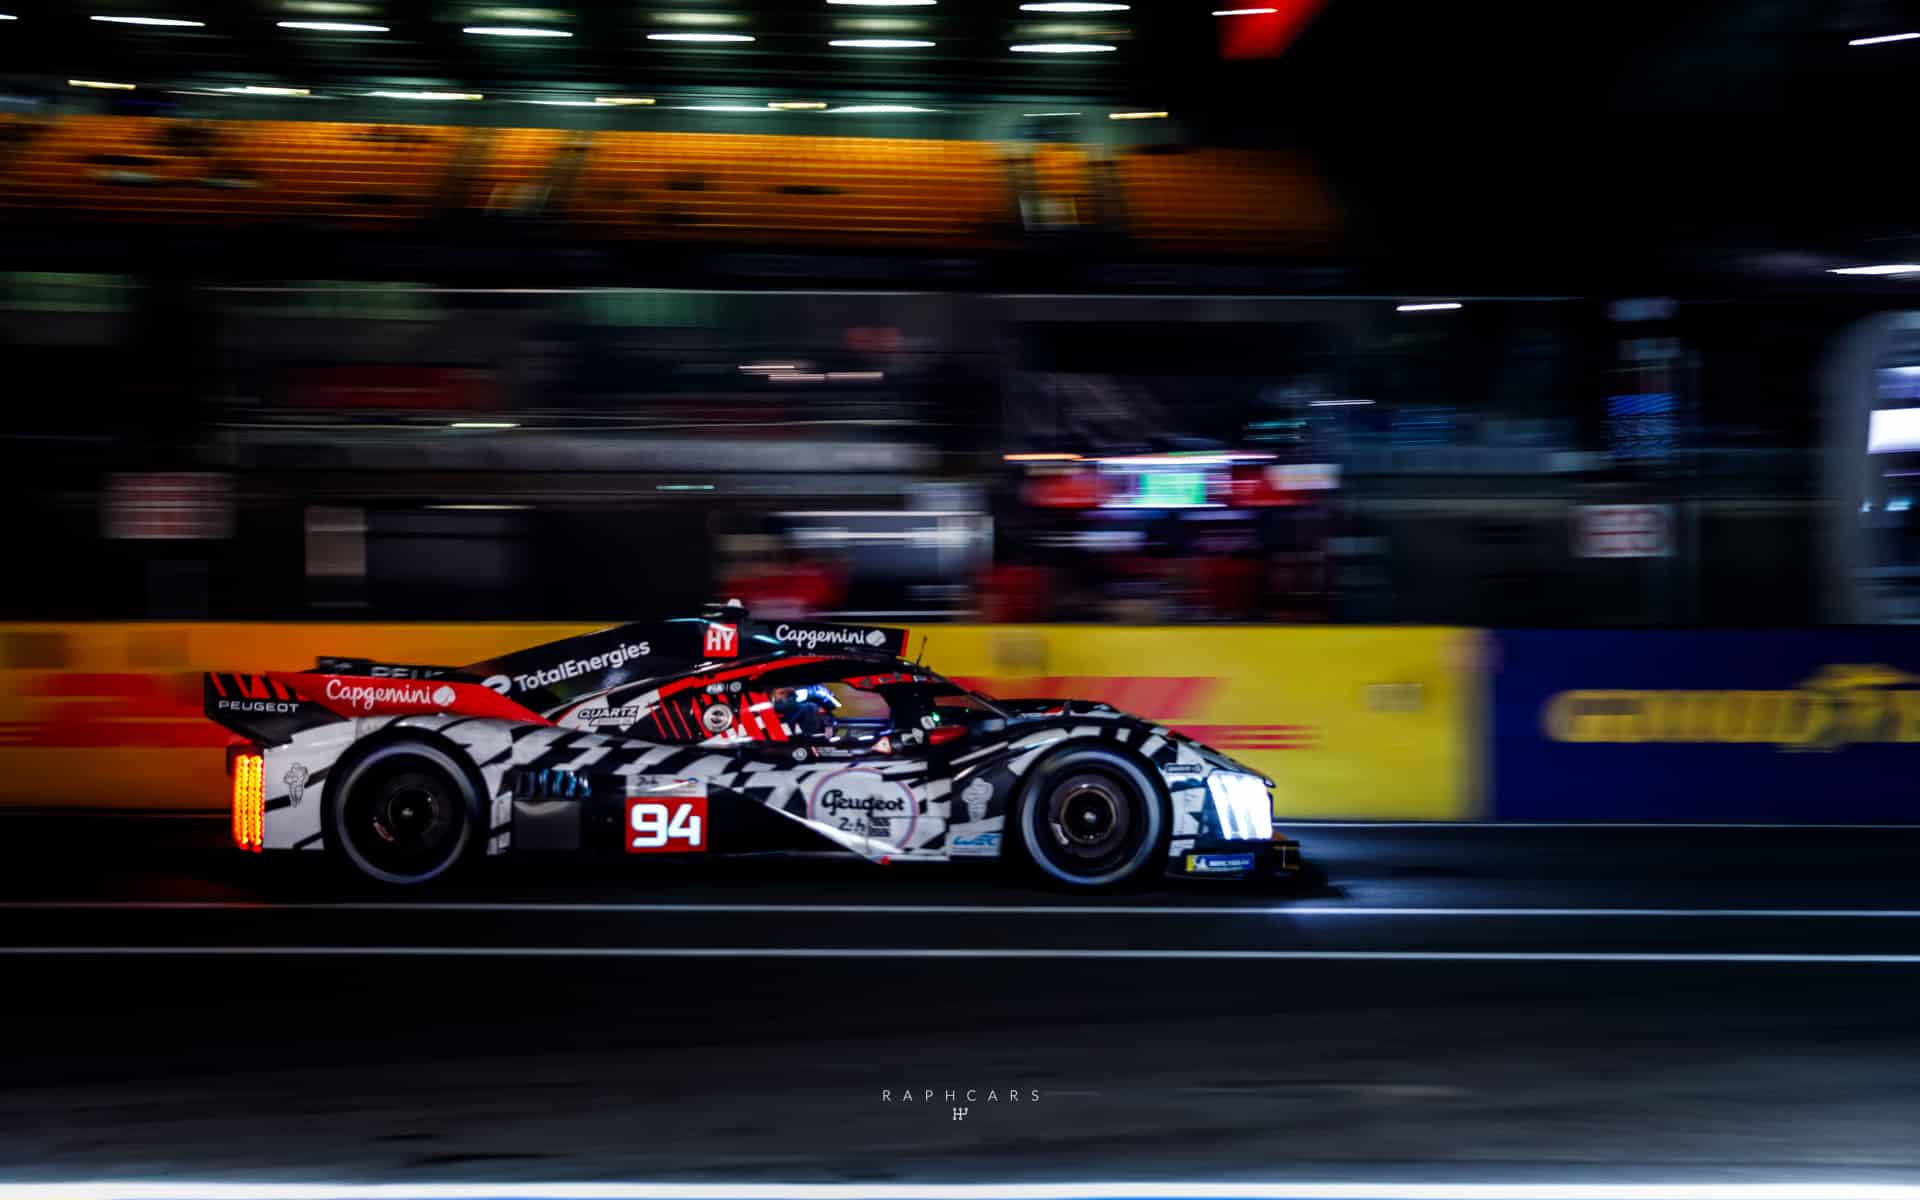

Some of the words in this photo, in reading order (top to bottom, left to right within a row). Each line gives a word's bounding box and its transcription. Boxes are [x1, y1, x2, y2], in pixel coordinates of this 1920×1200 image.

[706, 628, 735, 651] HY
[775, 624, 865, 649] Capgemini
[513, 641, 651, 691] TotalEnergies
[218, 700, 299, 713] PEUGEOT
[326, 679, 431, 710] Capgemini
[578, 705, 640, 721] QUARTZ
[821, 788, 904, 817] Peugeot
[631, 803, 702, 848] 94
